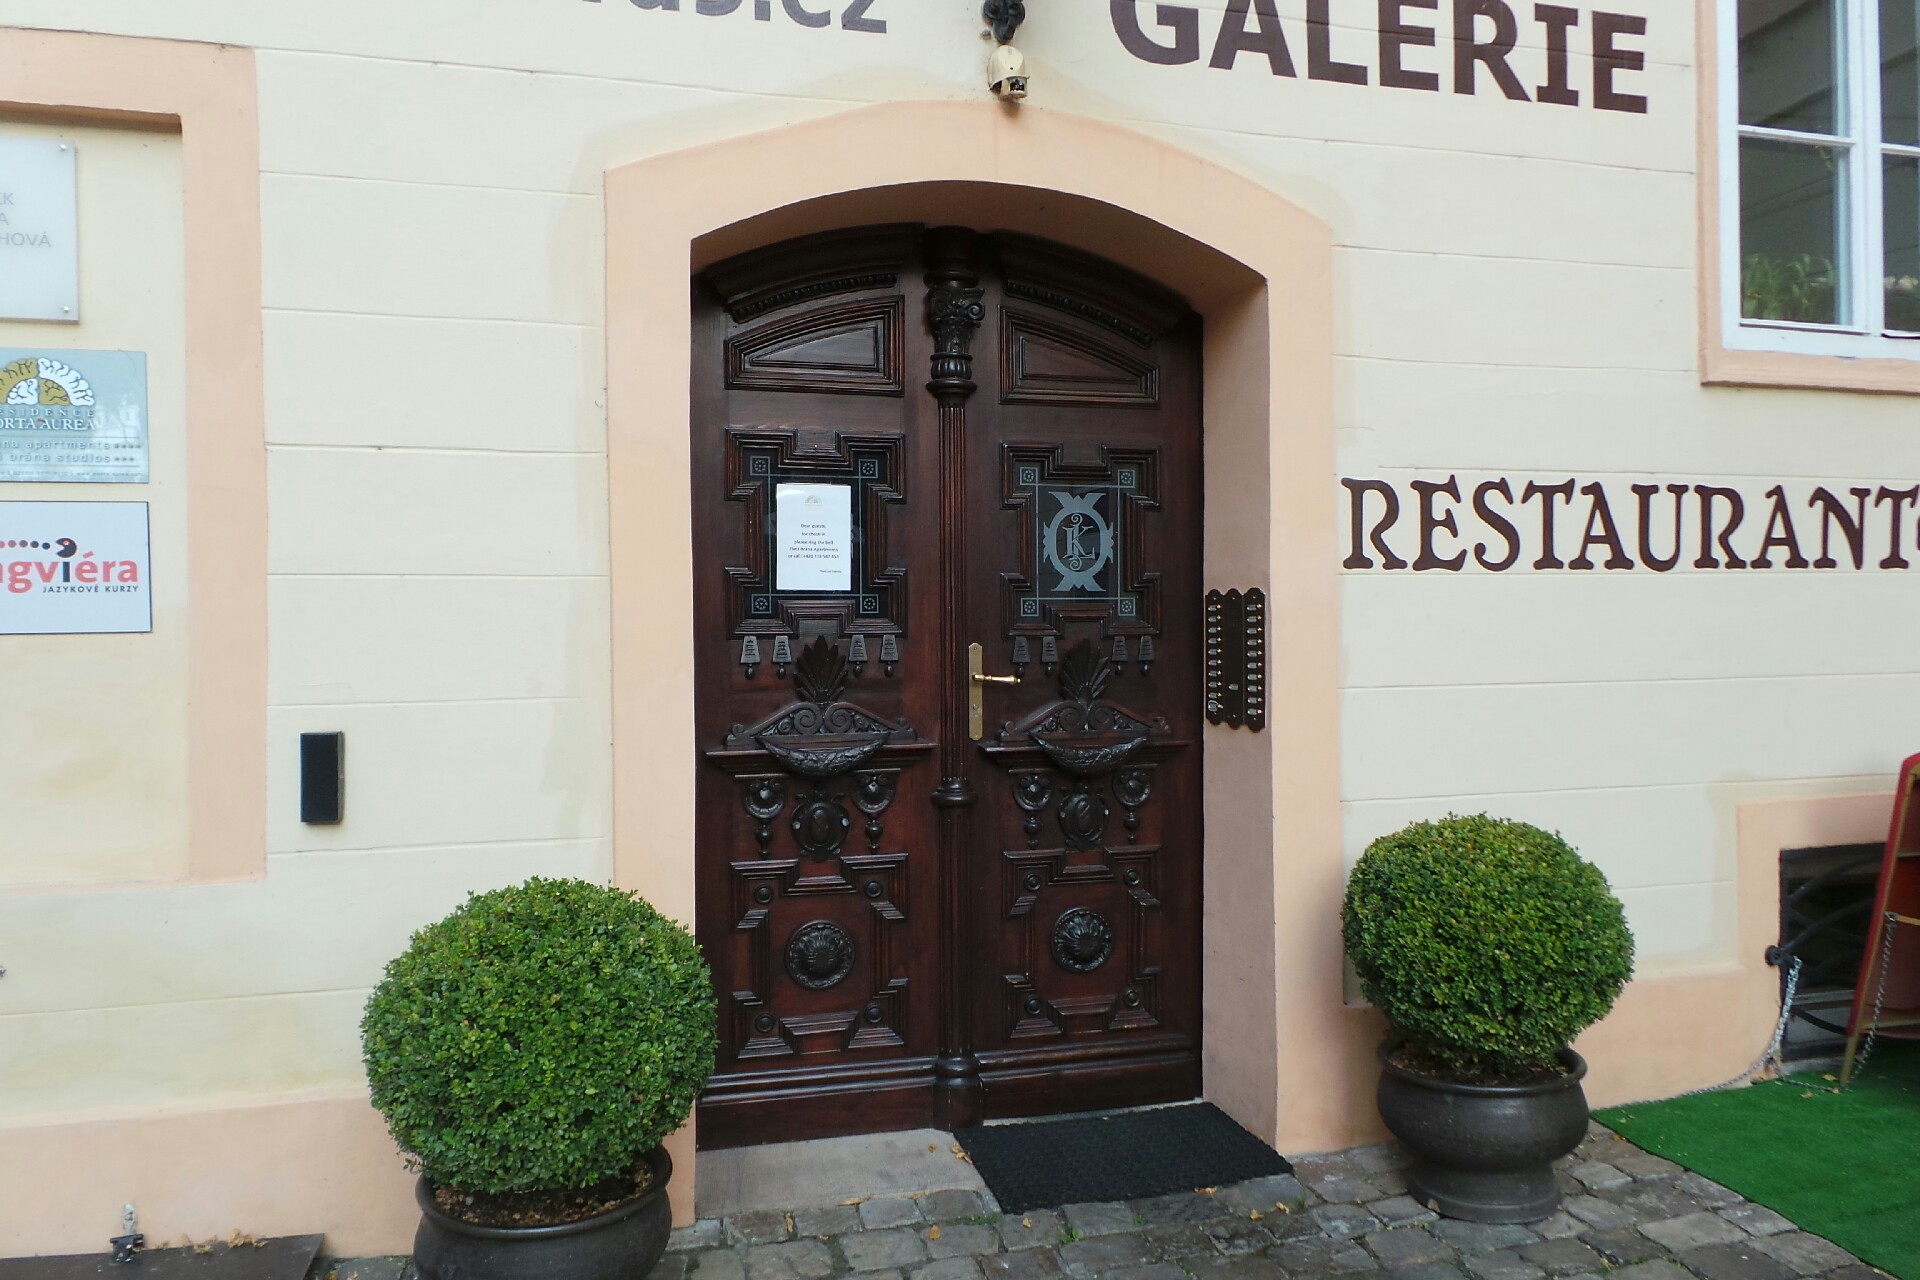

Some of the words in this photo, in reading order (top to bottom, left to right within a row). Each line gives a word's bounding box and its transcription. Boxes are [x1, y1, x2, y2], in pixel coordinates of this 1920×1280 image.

[1110, 0, 1647, 114] GALERIE
[39, 418, 96, 430] AUREA
[26, 440, 111, 451] apartments
[57, 453, 111, 463] studios
[1341, 474, 1918, 573] RESTAURANT
[43, 585, 99, 593] JAZYKOVÉ
[105, 585, 138, 593] KURZY
